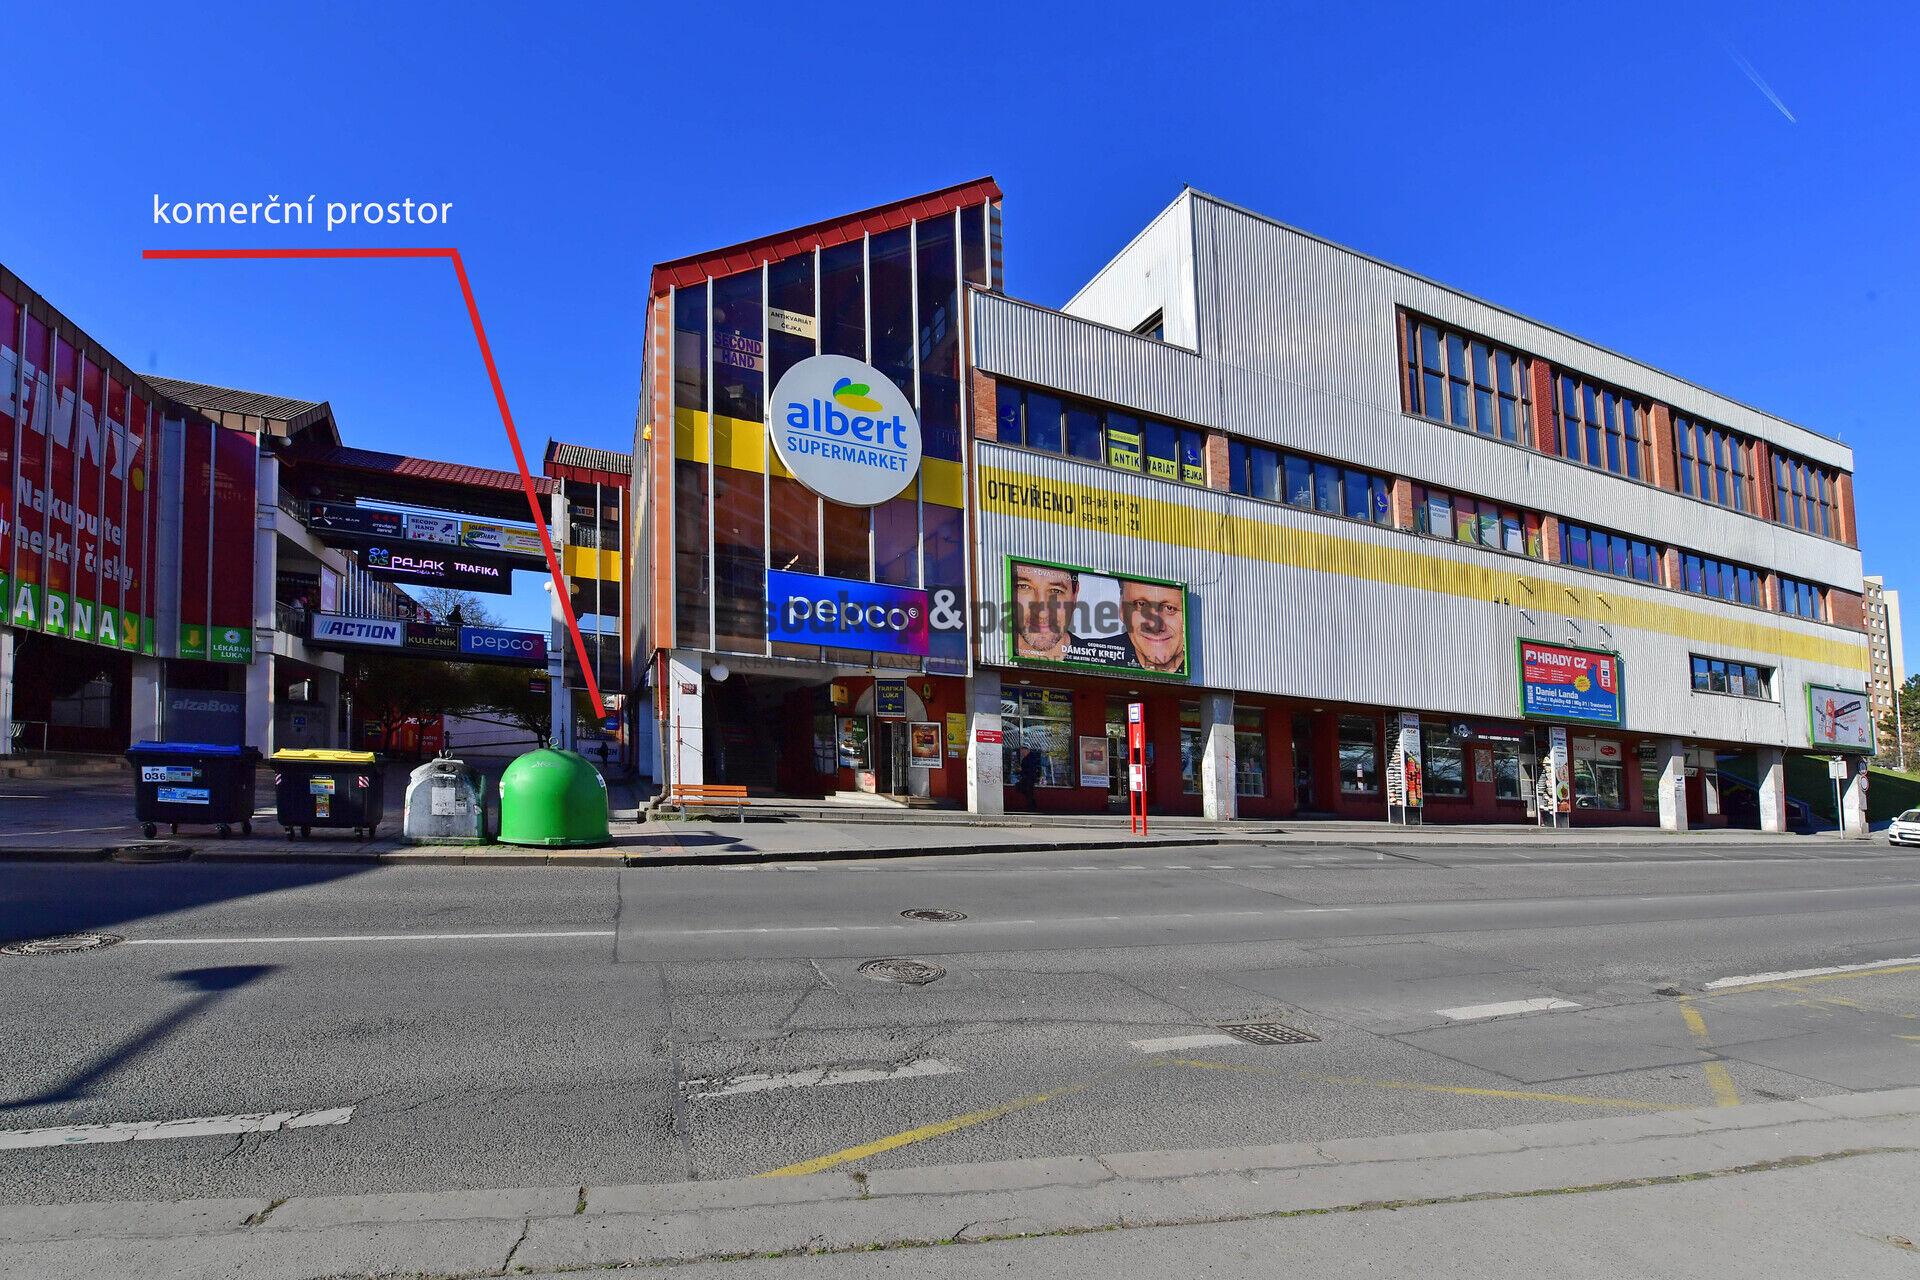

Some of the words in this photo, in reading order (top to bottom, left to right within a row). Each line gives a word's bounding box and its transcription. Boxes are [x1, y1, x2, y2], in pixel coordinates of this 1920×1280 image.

[715, 333, 762, 353] SECOND
[722, 351, 755, 368] HAND
[786, 398, 907, 449] albert
[787, 436, 907, 472] SUPERMARKET
[988, 480, 1074, 515] OTEVŘENO
[18, 475, 121, 546] Nakupte
[411, 518, 438, 526] SECOND
[15, 516, 81, 568] hezky
[454, 562, 499, 577] TRAFIKA
[788, 595, 909, 631] pepco
[329, 621, 396, 640] ACTION
[408, 636, 457, 647] KULEČNÍK
[471, 634, 534, 651] pepco
[221, 651, 243, 659] LUKA
[1061, 645, 1097, 657] DÁMSKÝ
[1099, 649, 1125, 661] KREJČÍ
[1537, 651, 1572, 667] HRADY
[1574, 657, 1587, 669] CZ
[1535, 686, 1557, 696] Daniel
[1559, 688, 1579, 699] Landa
[171, 699, 240, 713] alzaBox
[144, 772, 166, 781] 036
